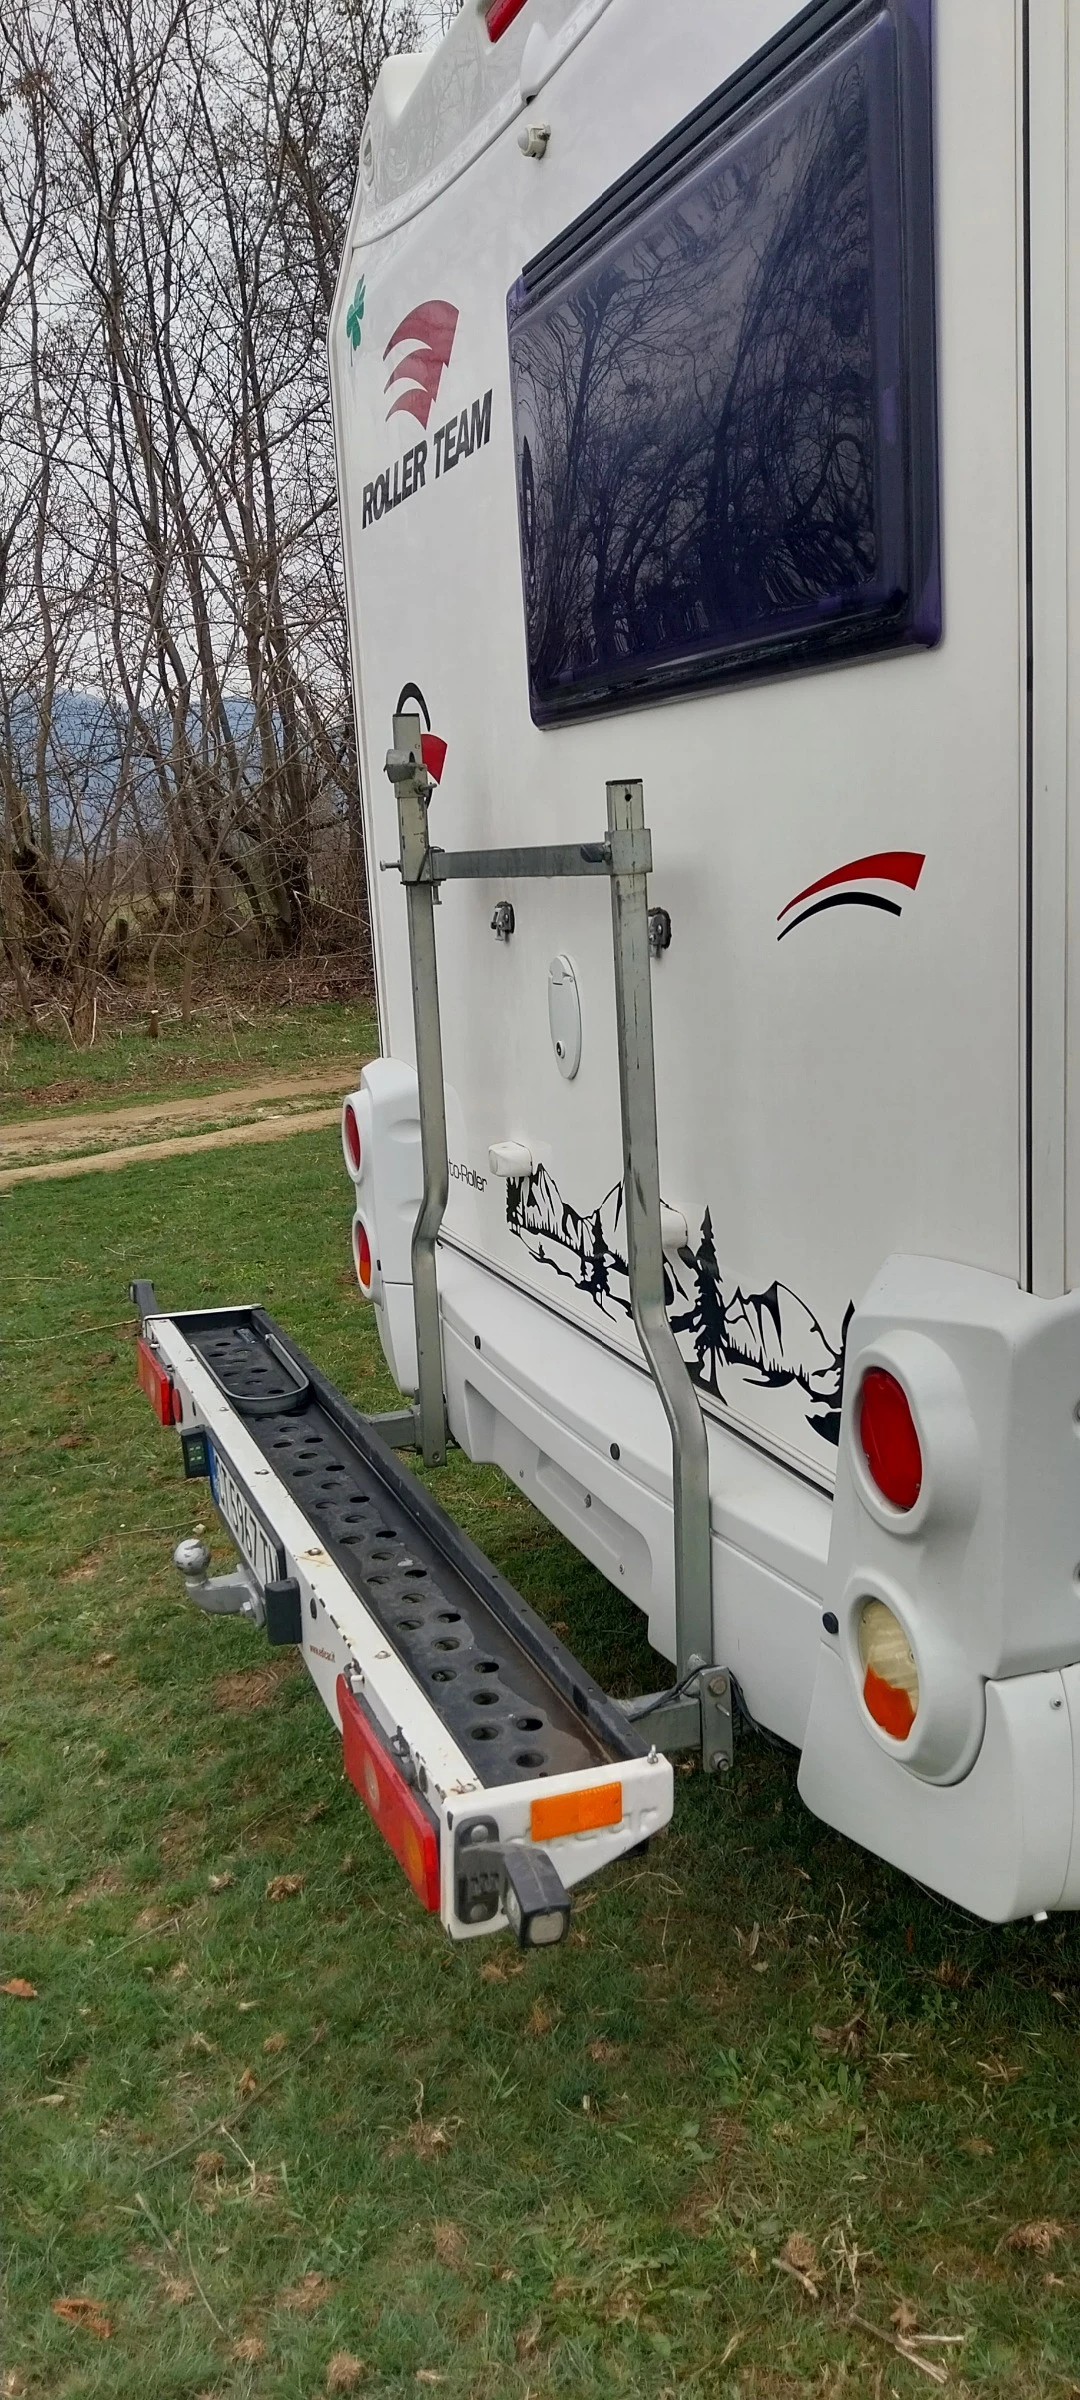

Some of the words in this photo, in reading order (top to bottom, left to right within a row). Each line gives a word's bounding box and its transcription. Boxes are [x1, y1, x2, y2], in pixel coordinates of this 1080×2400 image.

[362, 440, 427, 529] ROLLER
[433, 388, 493, 479] TEAM
[229, 1480, 257, 1568] 5967
